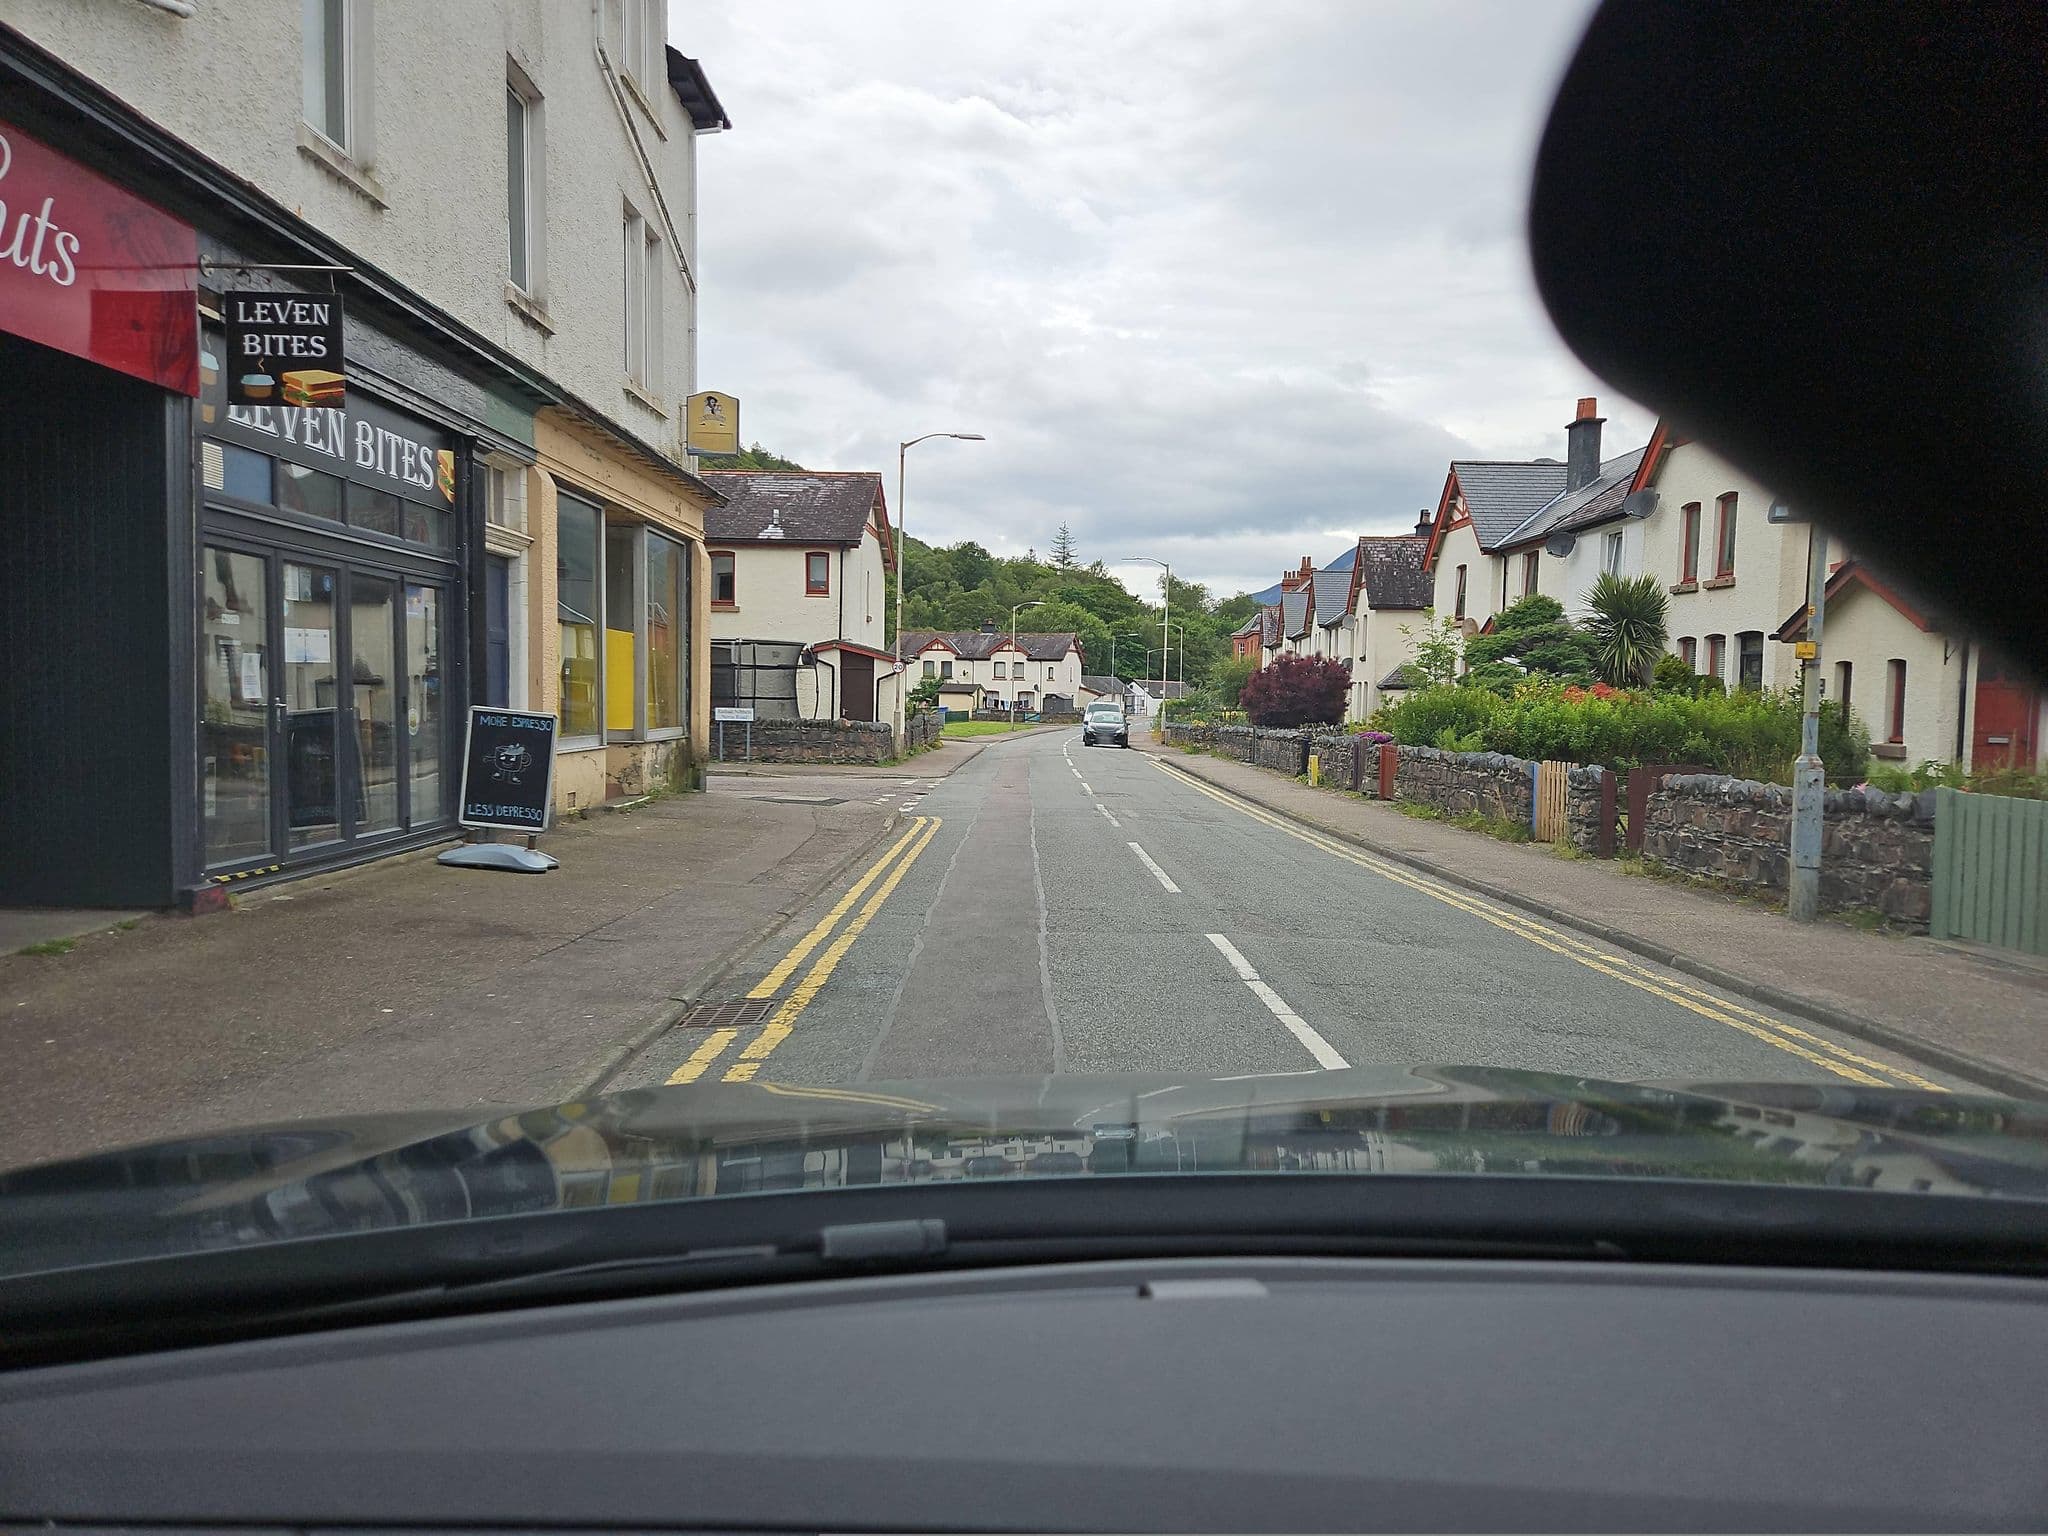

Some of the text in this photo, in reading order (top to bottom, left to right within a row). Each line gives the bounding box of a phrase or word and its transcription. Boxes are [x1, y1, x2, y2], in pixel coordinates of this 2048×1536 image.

[237, 300, 330, 326] LEVEN
[243, 334, 328, 358] BITES
[355, 420, 435, 491] BITES
[480, 715, 552, 731] MORE ESPRESSO
[467, 803, 543, 821] LESS DEPRESSO
